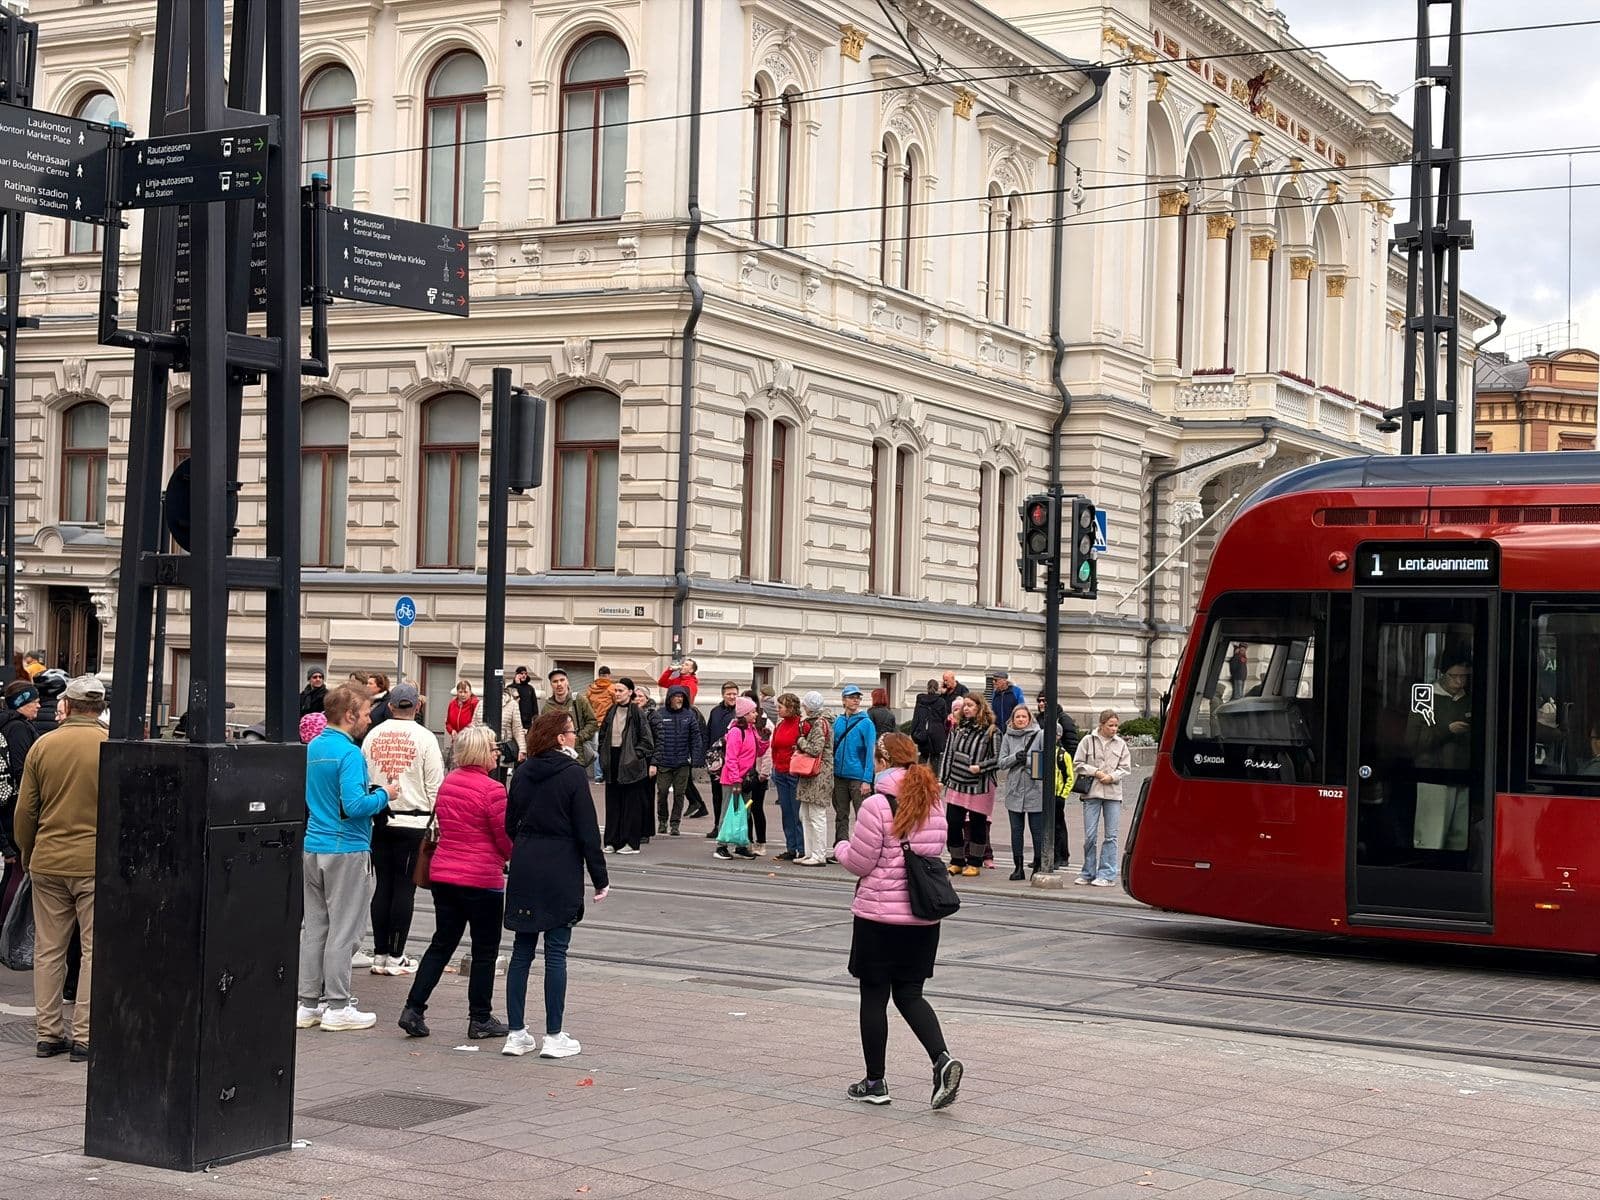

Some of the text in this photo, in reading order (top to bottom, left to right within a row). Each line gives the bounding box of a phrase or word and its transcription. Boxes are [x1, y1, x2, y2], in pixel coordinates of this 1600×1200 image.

[28, 117, 72, 134] Laukontori
[26, 128, 52, 142] Market
[52, 134, 71, 145] Place
[147, 143, 191, 155] Rautatieasema
[26, 150, 70, 167] Kehräsaari
[146, 155, 185, 167] Railway Station
[12, 159, 45, 174] Boutique
[46, 166, 70, 178] Centre
[145, 176, 194, 189] Linja-autoasema
[4, 179, 69, 200] Ratinan stadion
[145, 189, 174, 199] Bus Station
[15, 193, 68, 211] Ratina Stadium
[353, 217, 385, 230] Keskustori
[353, 228, 391, 241] Central Square
[353, 246, 426, 266] Tampereen Vanha Kirkko
[353, 257, 383, 268] Old Church
[353, 275, 401, 290] Finlaysonin alue
[353, 285, 391, 298] Finlayson Area
[1370, 553, 1384, 576] 1
[373, 737, 415, 746] Stockholm
[370, 743, 417, 754] Gothenburg
